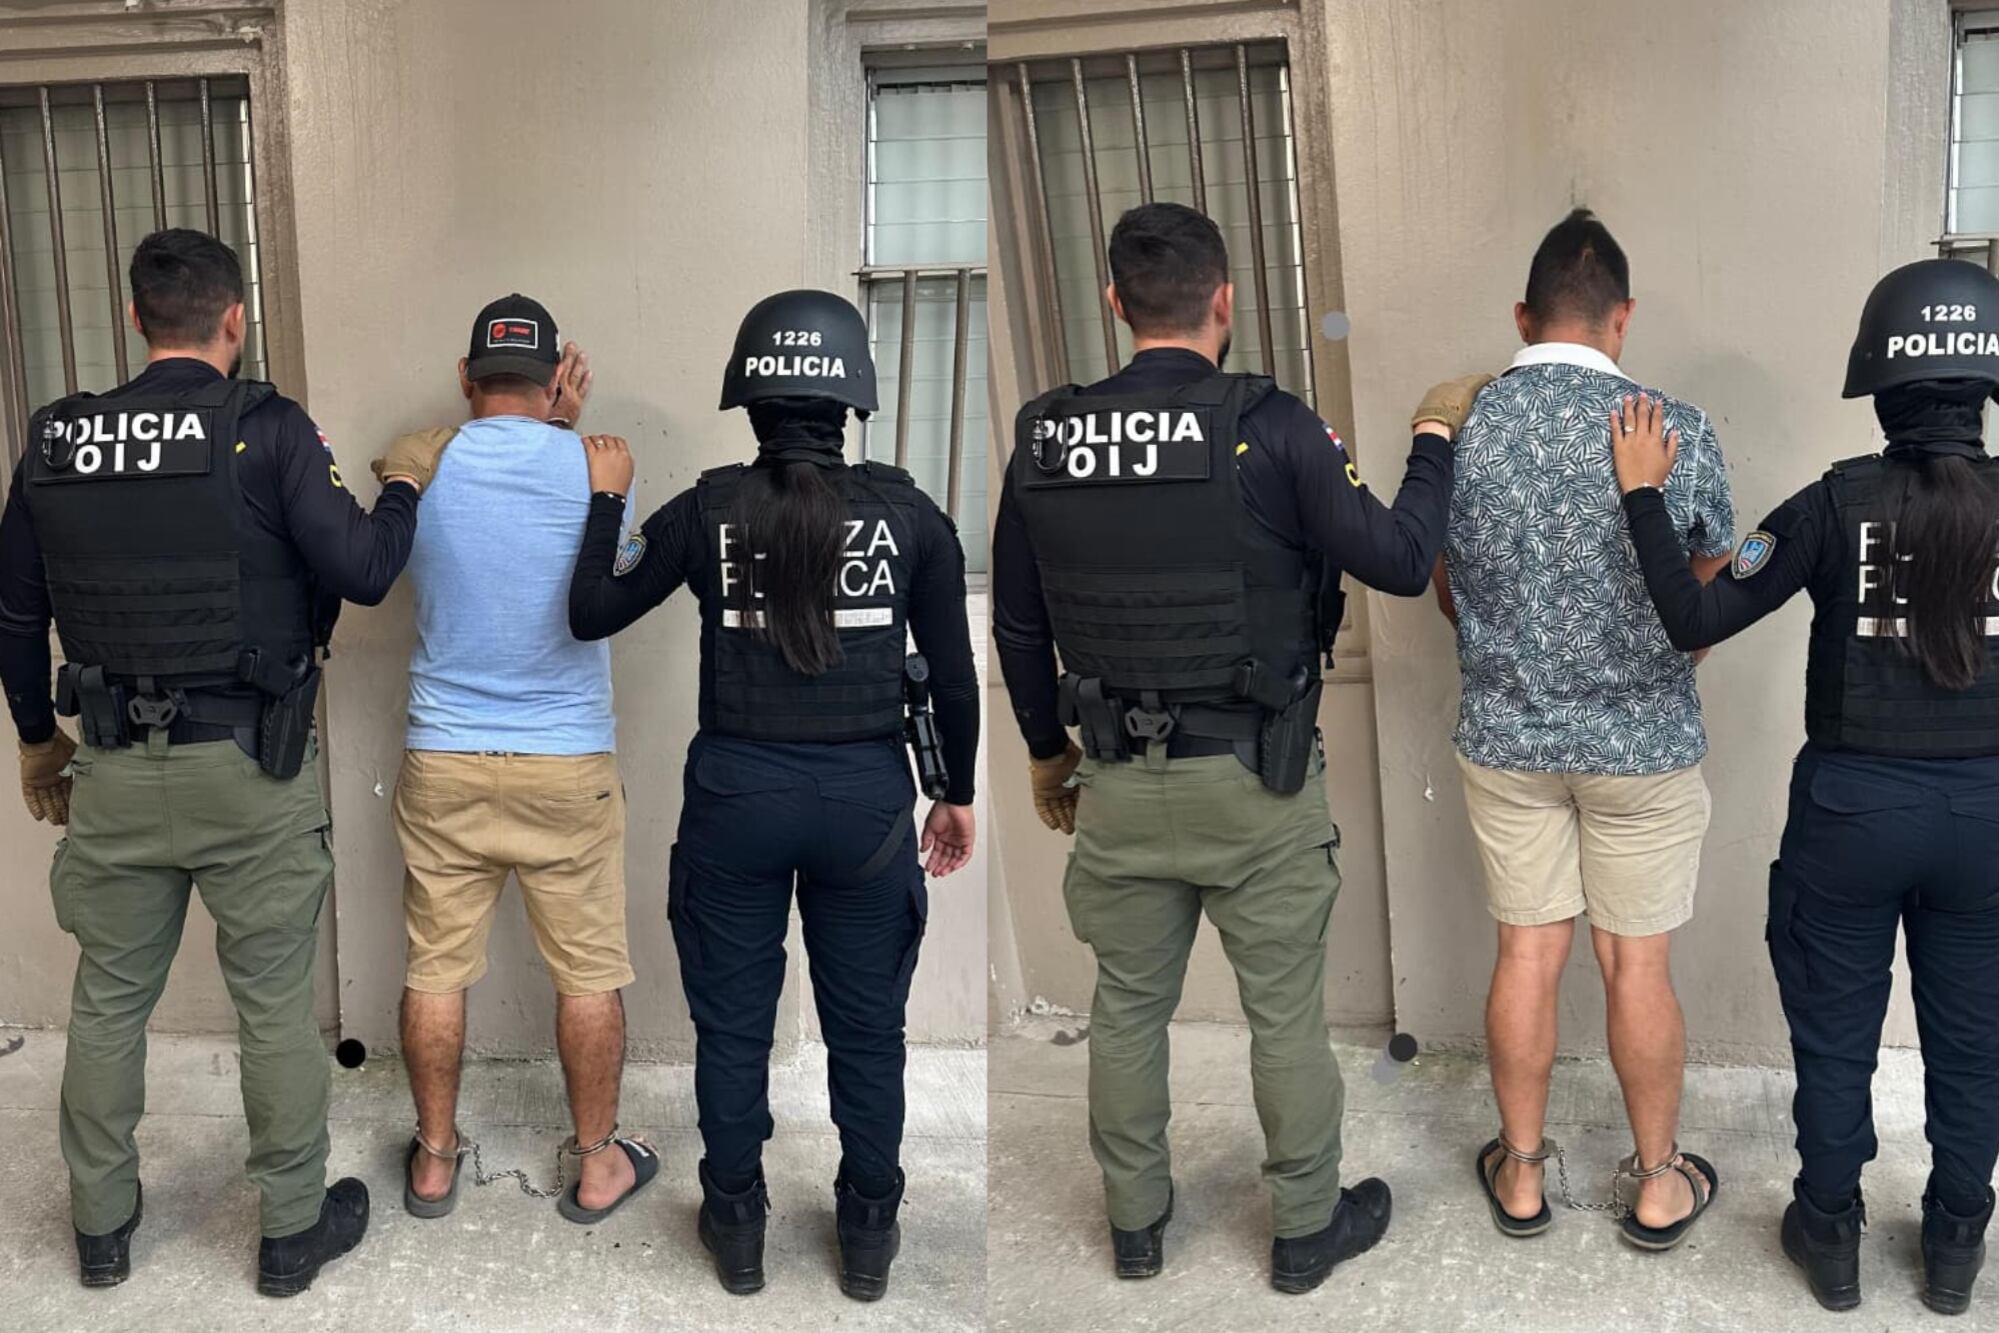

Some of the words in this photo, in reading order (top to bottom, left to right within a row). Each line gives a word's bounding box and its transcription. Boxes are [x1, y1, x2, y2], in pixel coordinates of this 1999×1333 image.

[1920, 304, 1977, 322] 1226
[772, 330, 822, 347] 1226
[1887, 331, 1999, 359] POLICIA
[744, 355, 846, 379] POLICIA
